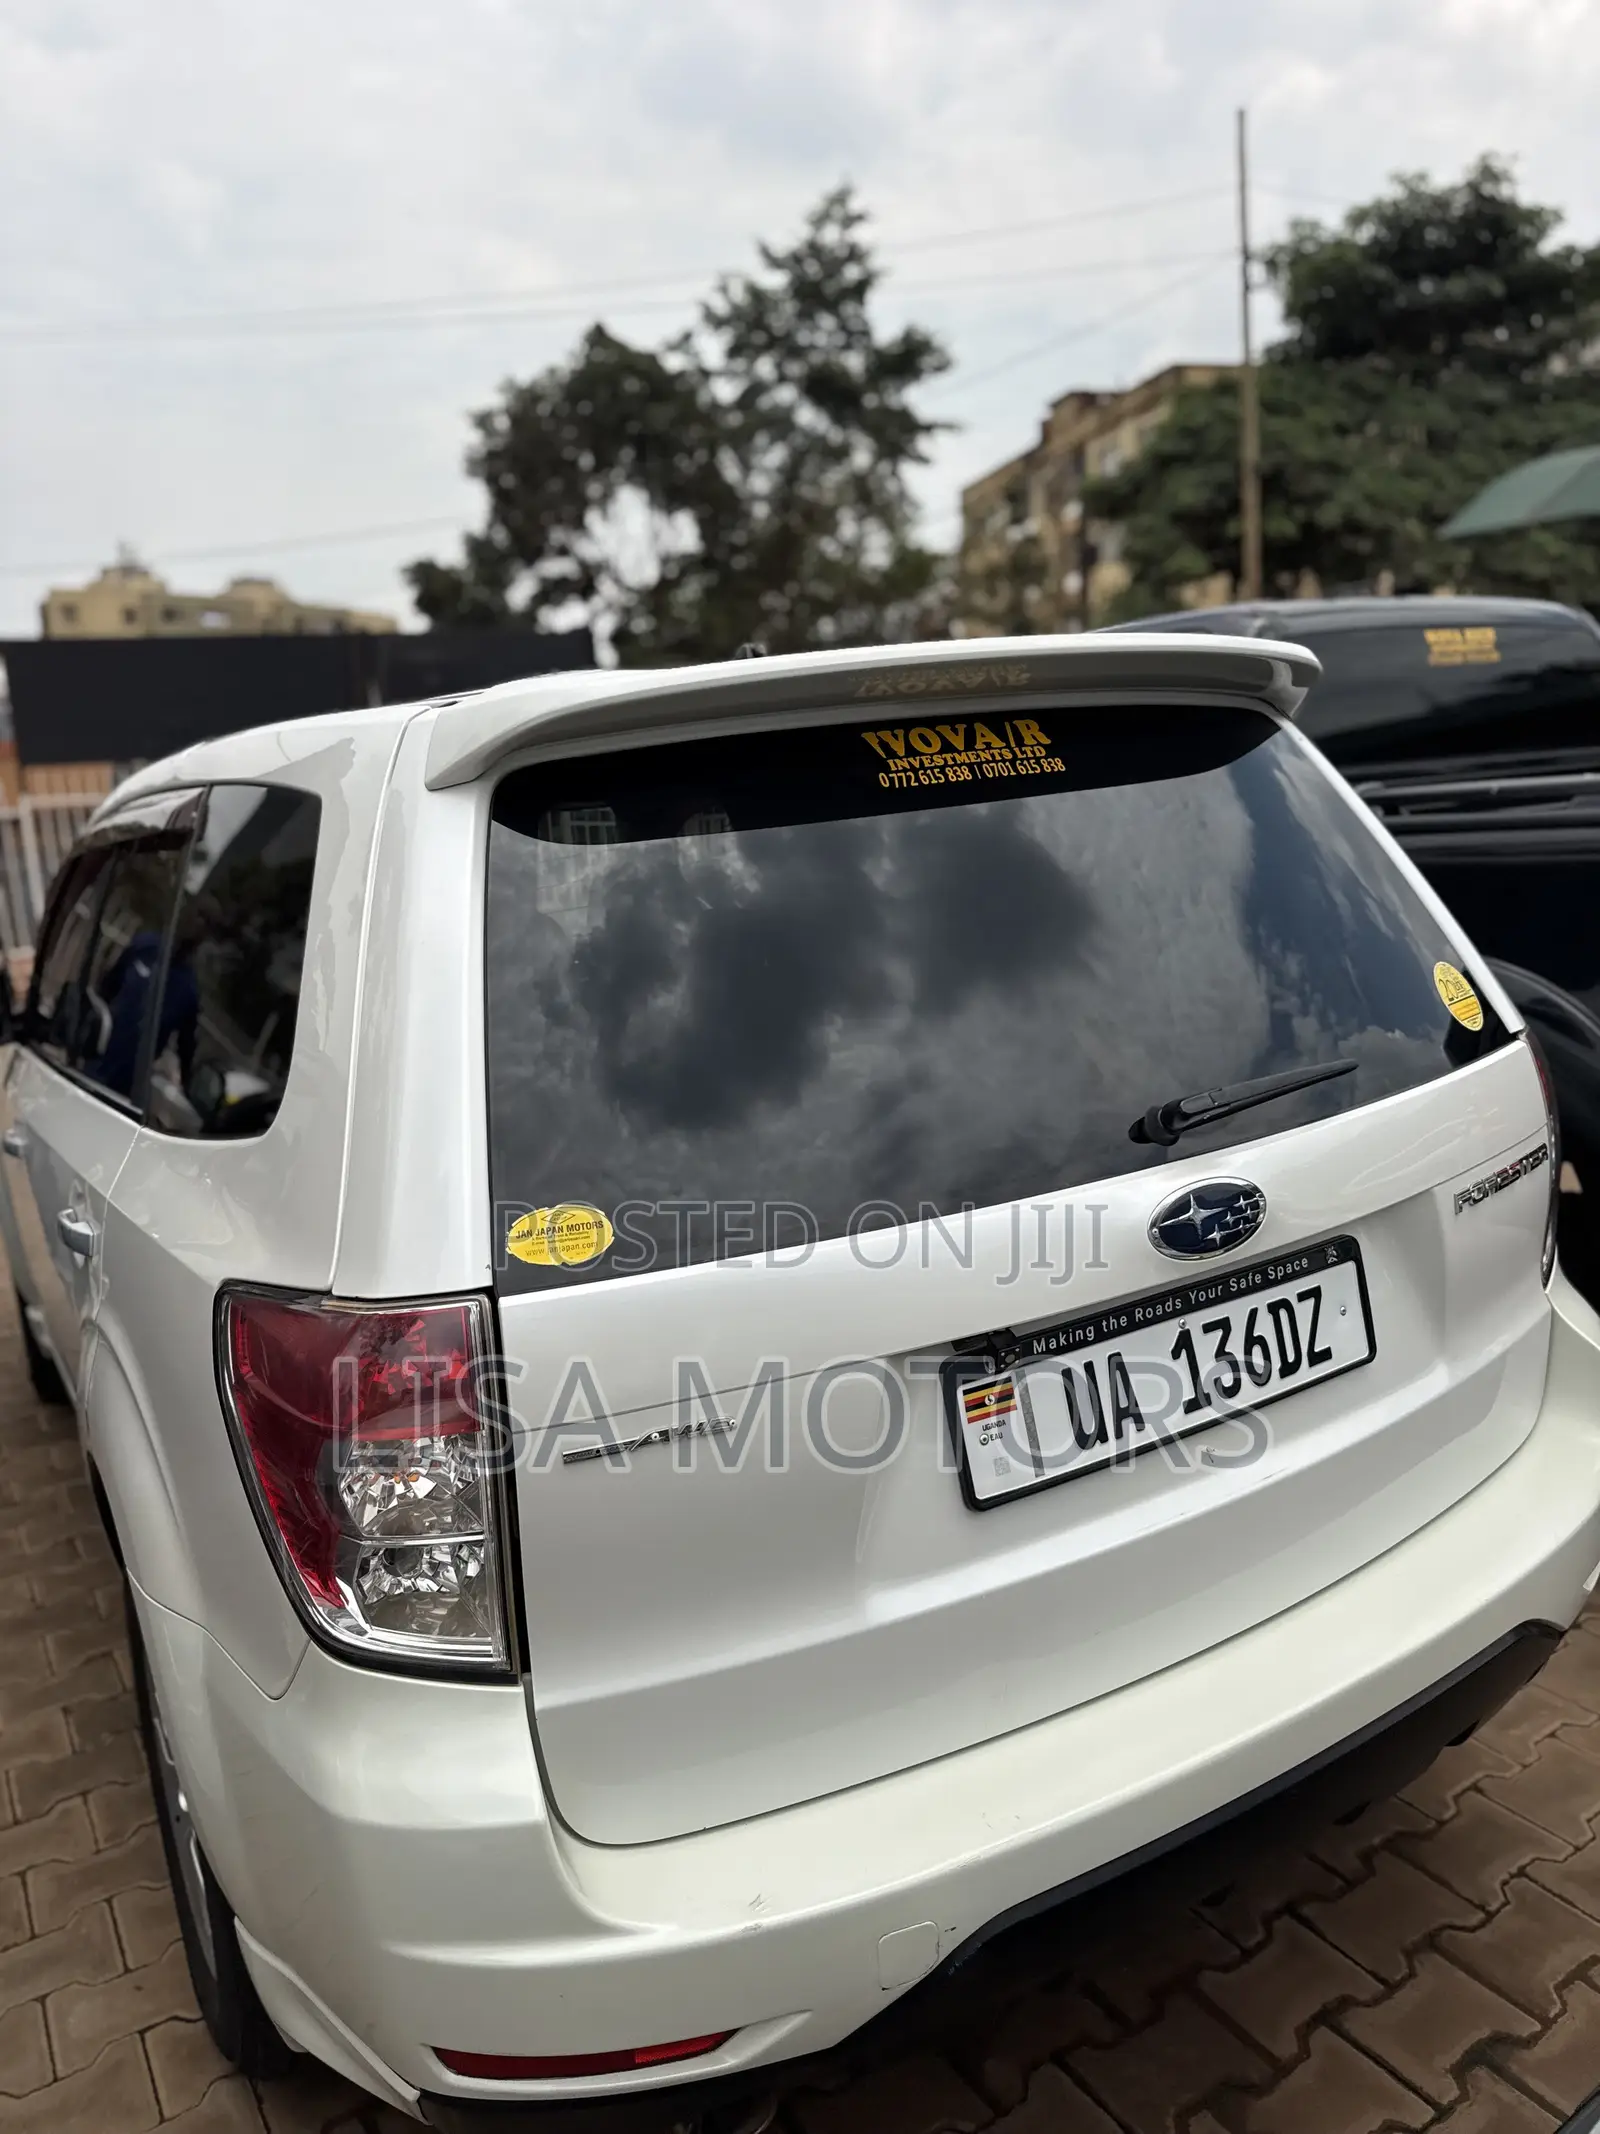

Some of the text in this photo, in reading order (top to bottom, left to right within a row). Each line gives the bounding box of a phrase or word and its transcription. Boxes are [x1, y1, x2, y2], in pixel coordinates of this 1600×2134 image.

[887, 745, 1047, 771] INVESTMENTS LTD
[878, 771, 919, 789] 0772
[919, 768, 945, 785] 615
[948, 765, 973, 782] 838
[983, 761, 1017, 778] 0701
[1016, 759, 1042, 775] 615
[1043, 757, 1067, 772] 838
[1453, 1142, 1549, 1215] FORESTER
[515, 1228, 533, 1240] JAN
[535, 1224, 564, 1238] JAPAN
[566, 1220, 604, 1234] MOTORS
[1032, 1257, 1309, 1355] Making the Roads Your Safe Space
[1061, 1284, 1334, 1452] UA 136DZ
[981, 1419, 1007, 1432] UGANDA
[989, 1432, 1004, 1442] EAU
